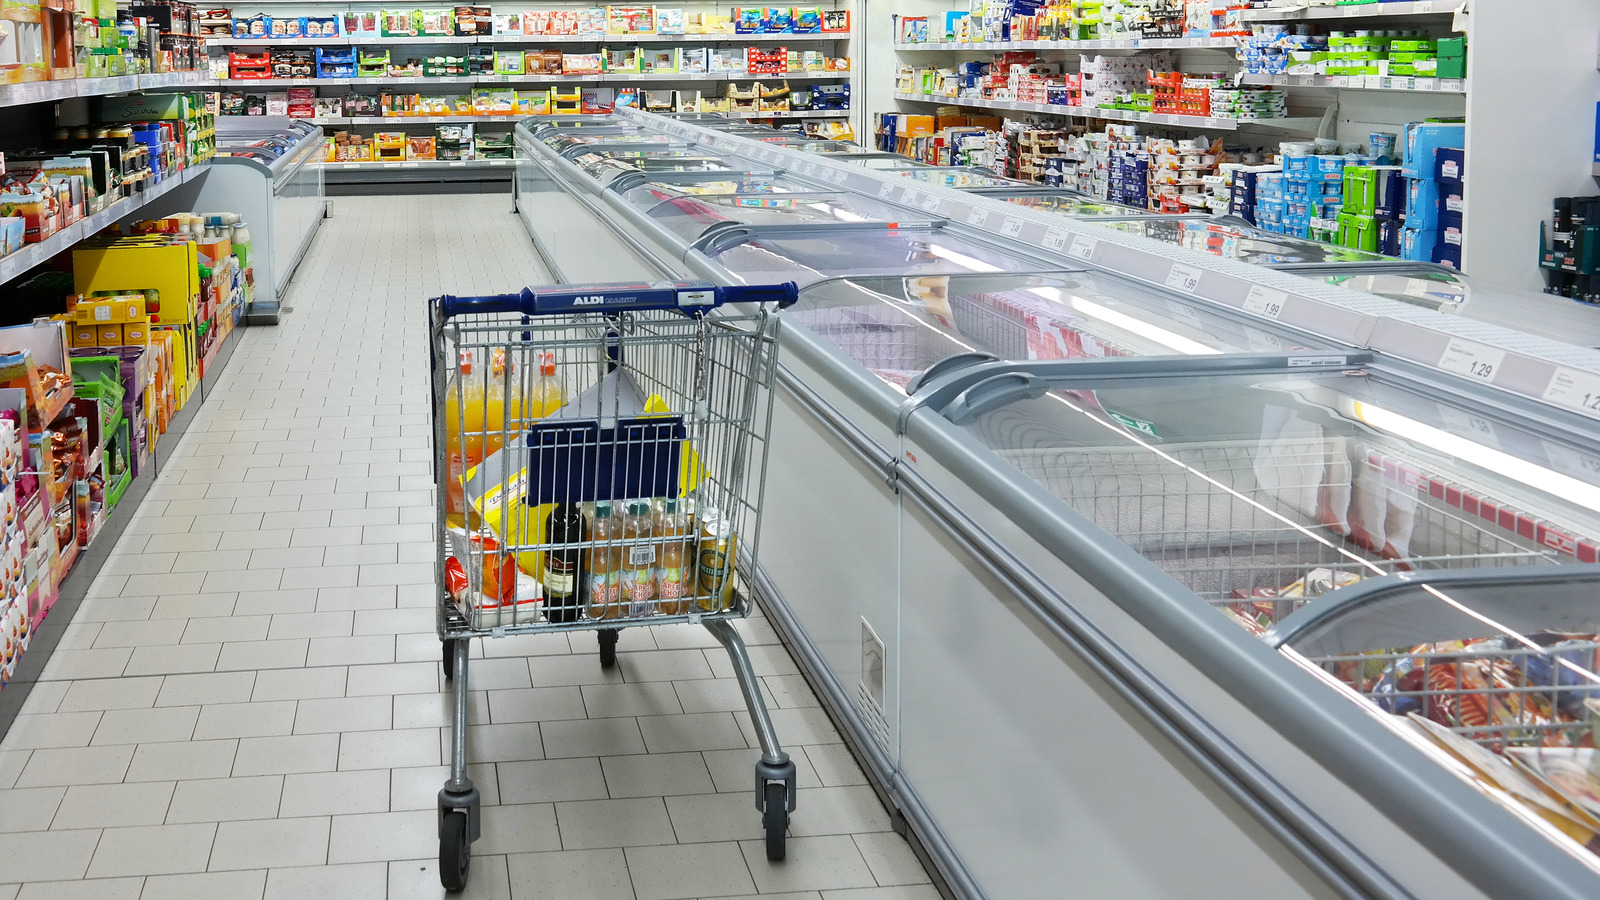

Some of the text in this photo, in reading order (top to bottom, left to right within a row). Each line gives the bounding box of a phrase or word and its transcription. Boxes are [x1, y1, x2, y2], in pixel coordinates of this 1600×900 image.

[1054, 236, 1064, 249] 1.99
[1081, 246, 1092, 259] 1.99
[1183, 277, 1197, 290] 1.99
[573, 296, 604, 306] ALDI
[1263, 302, 1280, 316] 1.99
[1470, 361, 1493, 378] 1.29
[1582, 393, 1600, 410] 1.2
